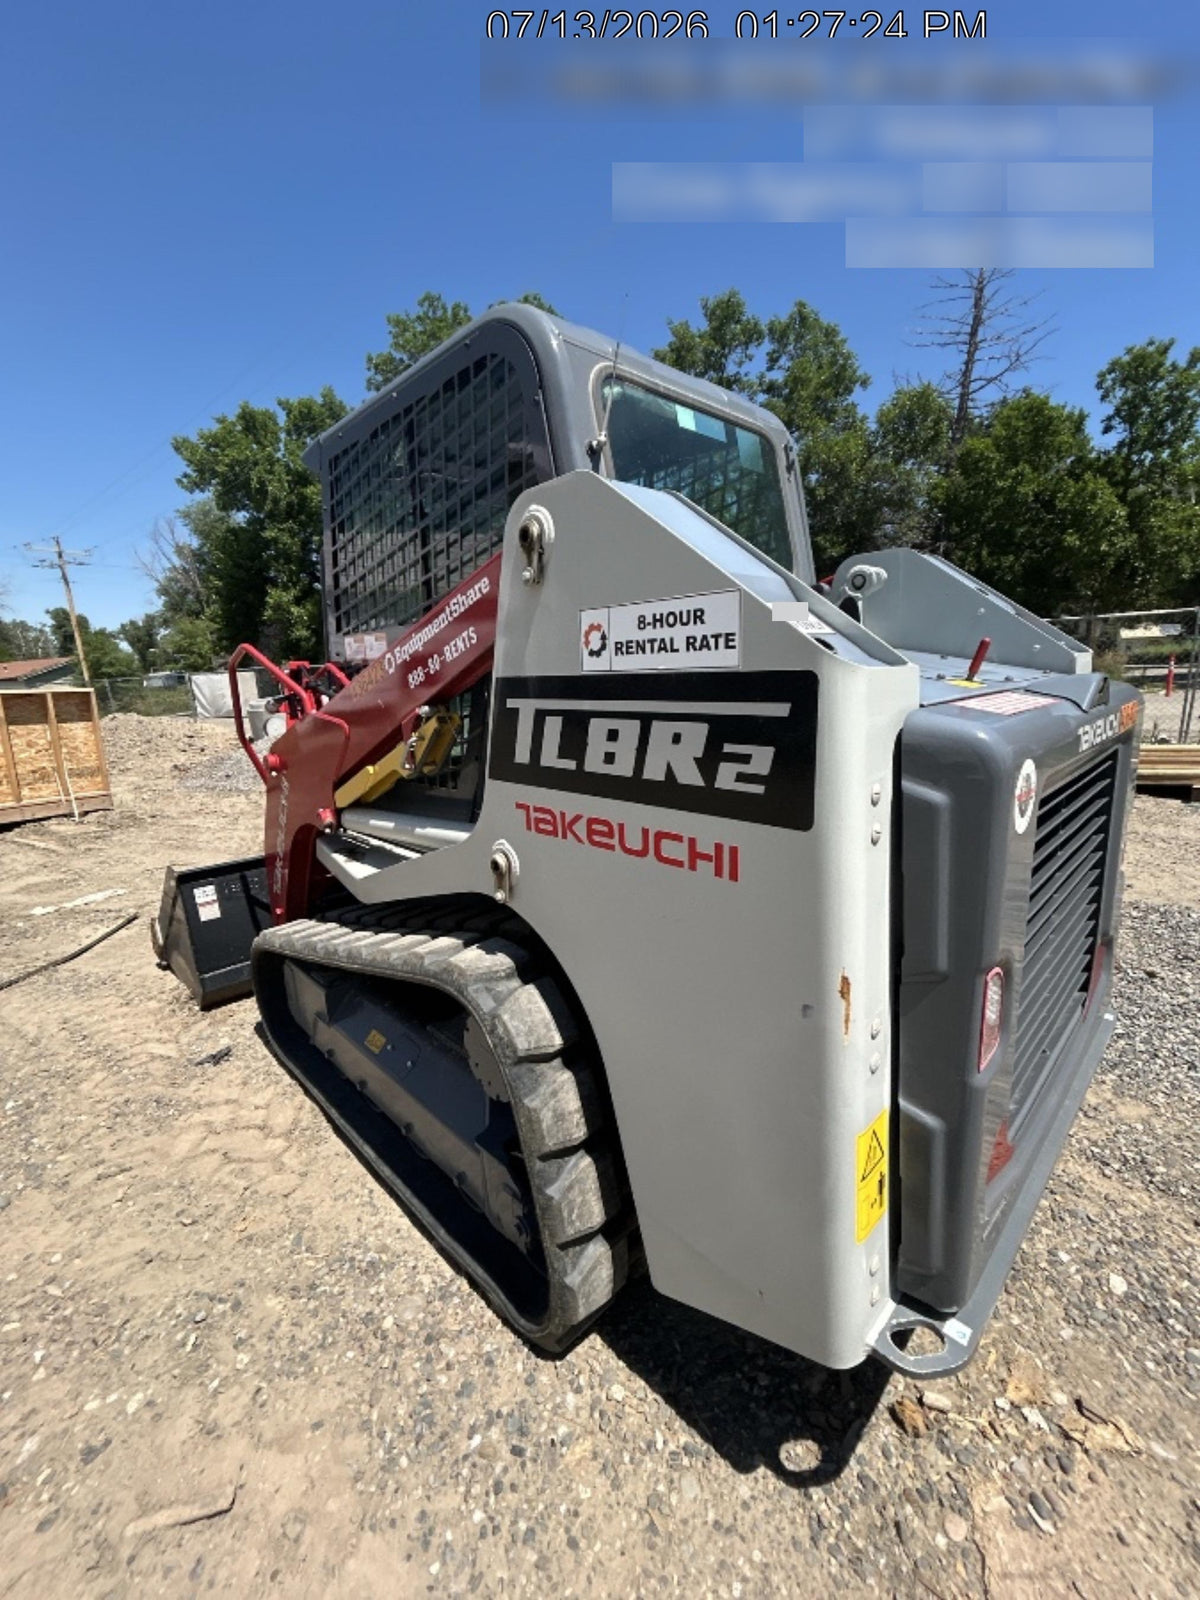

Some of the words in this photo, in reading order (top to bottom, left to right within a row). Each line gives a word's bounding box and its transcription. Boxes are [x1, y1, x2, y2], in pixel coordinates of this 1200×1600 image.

[394, 576, 491, 665] EquipmentShare
[637, 608, 706, 630] 8-HOUR
[614, 637, 680, 657] RENTAL
[685, 632, 737, 651] RATE
